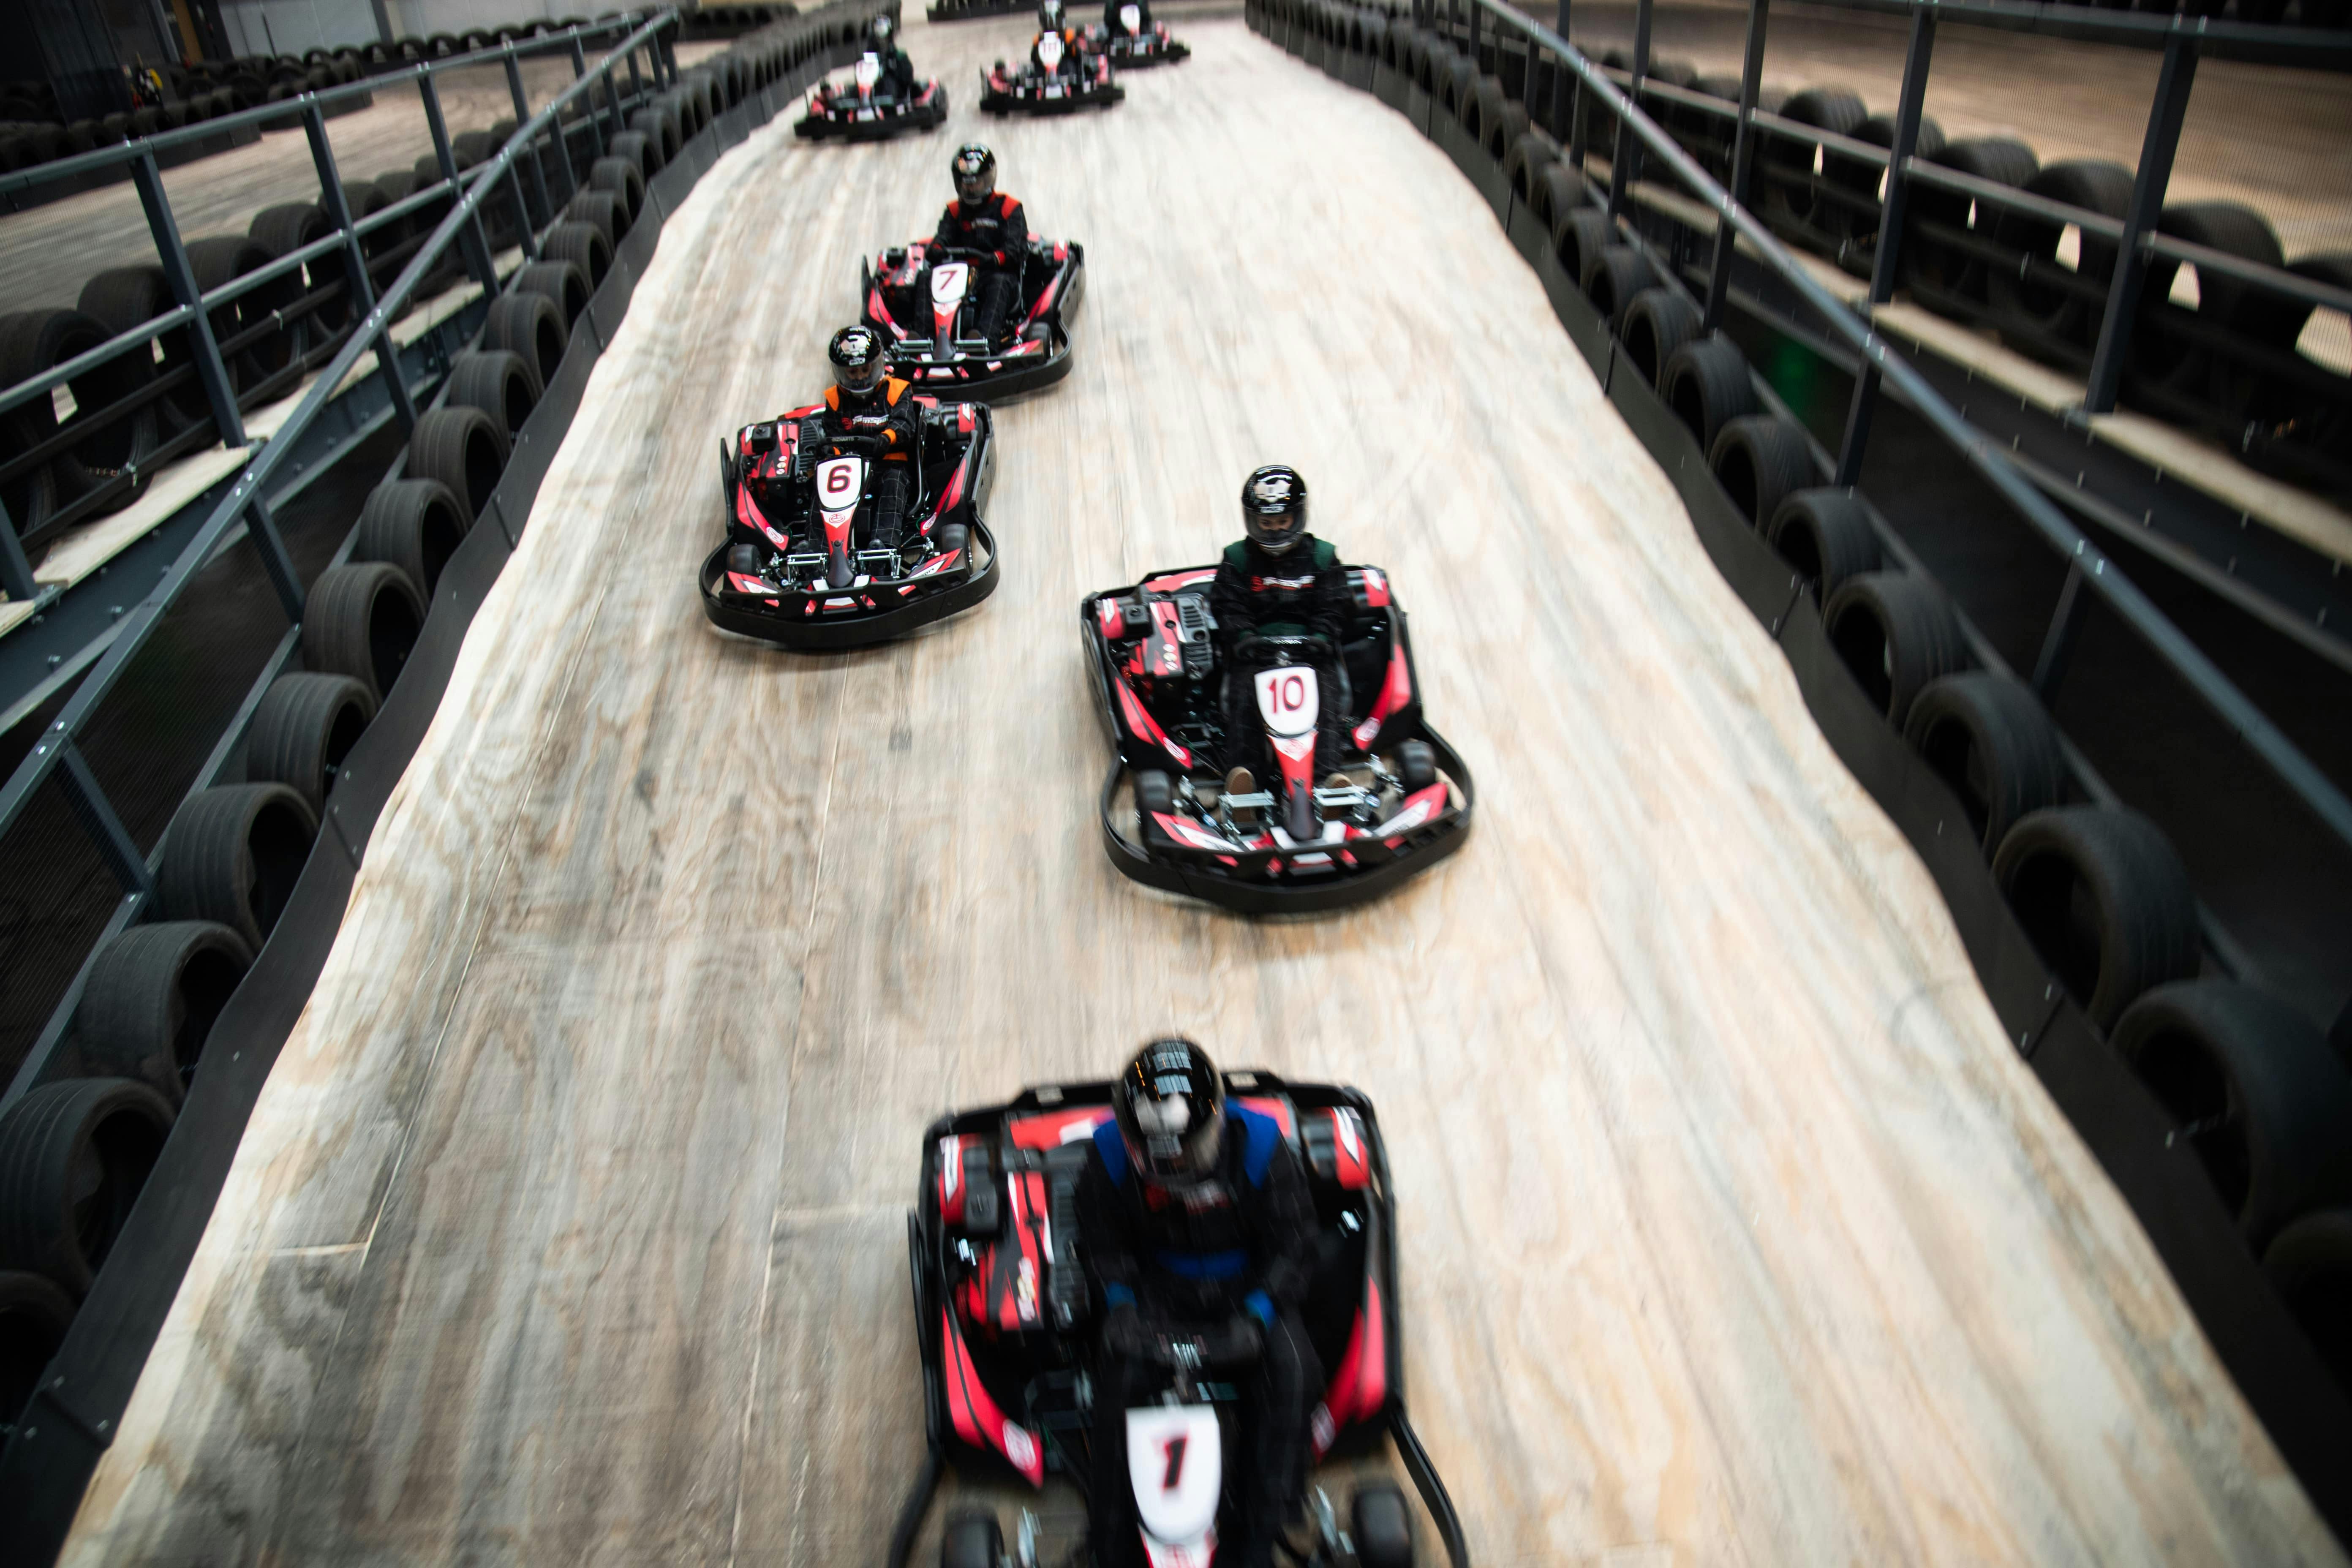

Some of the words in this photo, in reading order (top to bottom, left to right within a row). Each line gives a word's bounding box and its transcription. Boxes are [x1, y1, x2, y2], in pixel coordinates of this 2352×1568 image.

[939, 270, 958, 291] 7
[827, 464, 852, 493] 6
[1268, 675, 1304, 714] 10
[1155, 1431, 1190, 1493] 1
